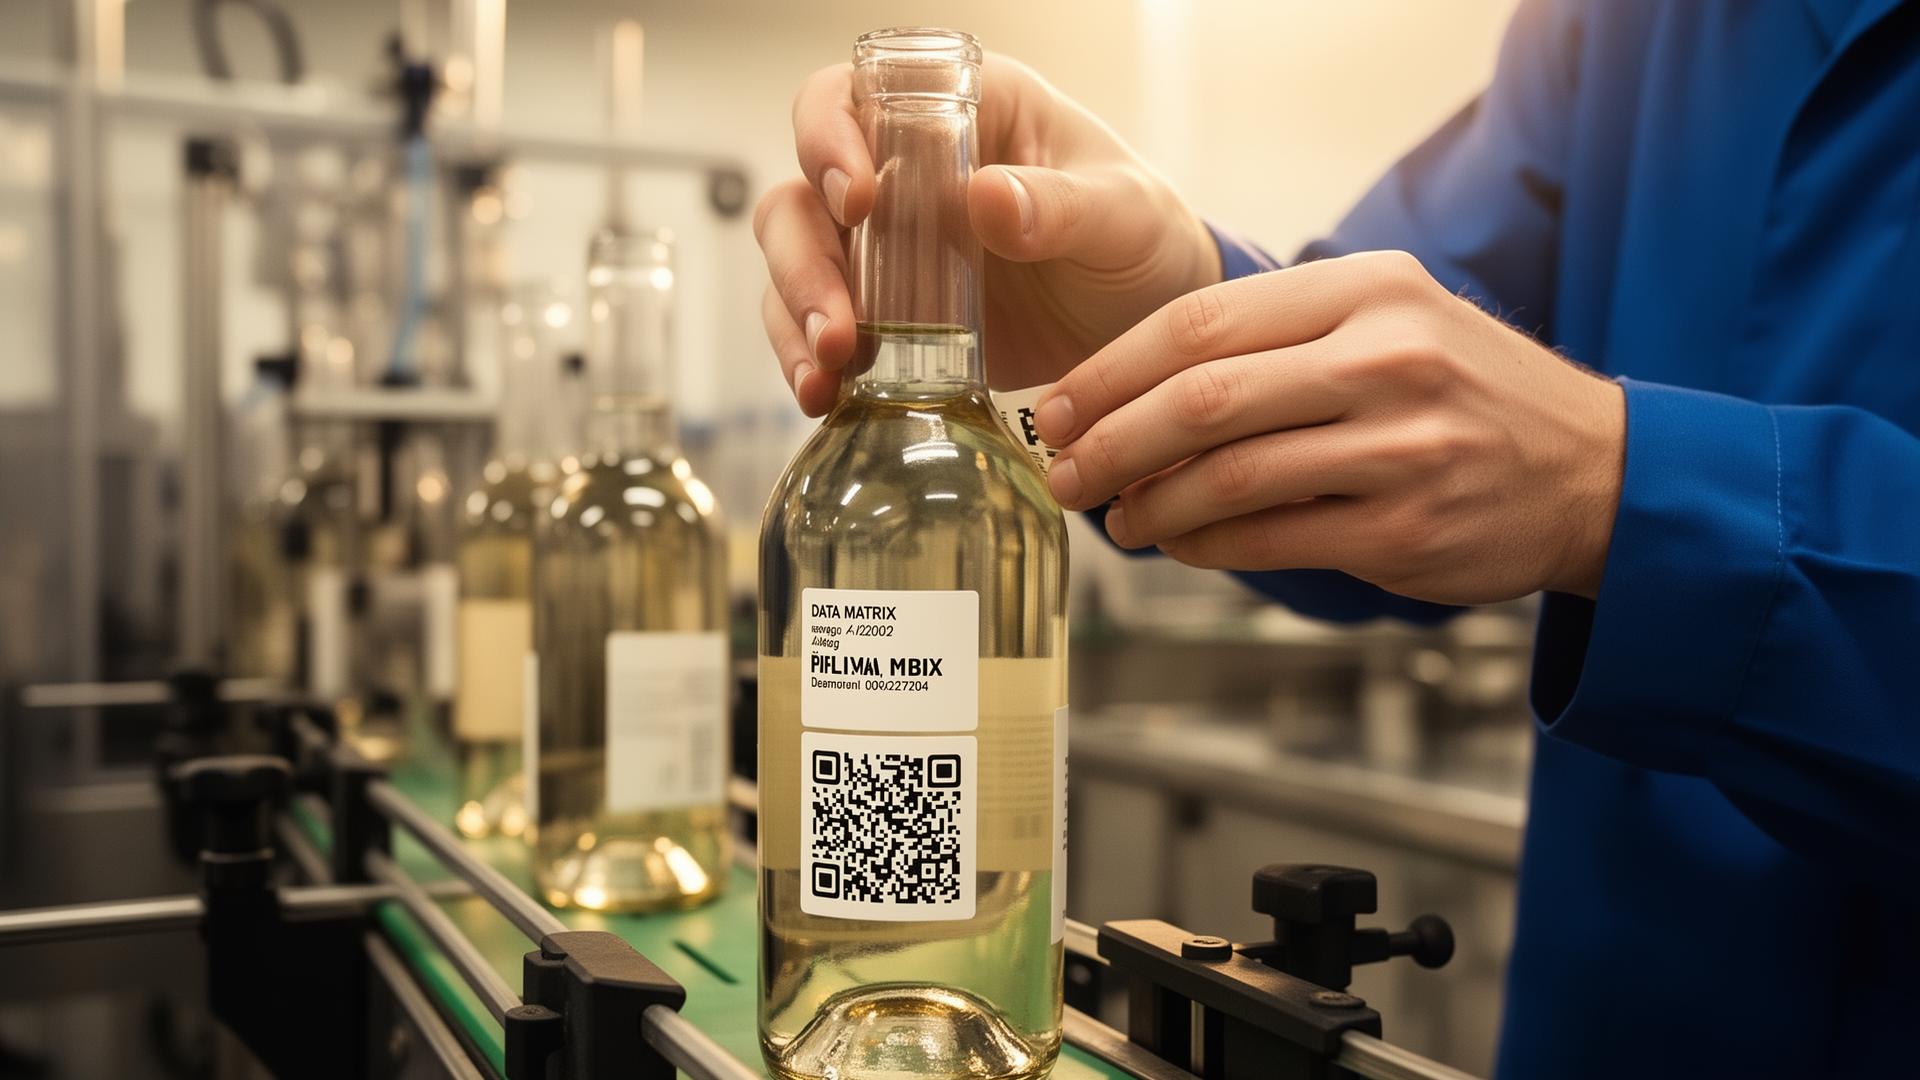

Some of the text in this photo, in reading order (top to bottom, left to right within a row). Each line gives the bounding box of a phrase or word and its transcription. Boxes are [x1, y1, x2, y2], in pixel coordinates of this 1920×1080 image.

[811, 604, 897, 620] DATA MATRIX
[889, 658, 943, 677] MBIX
